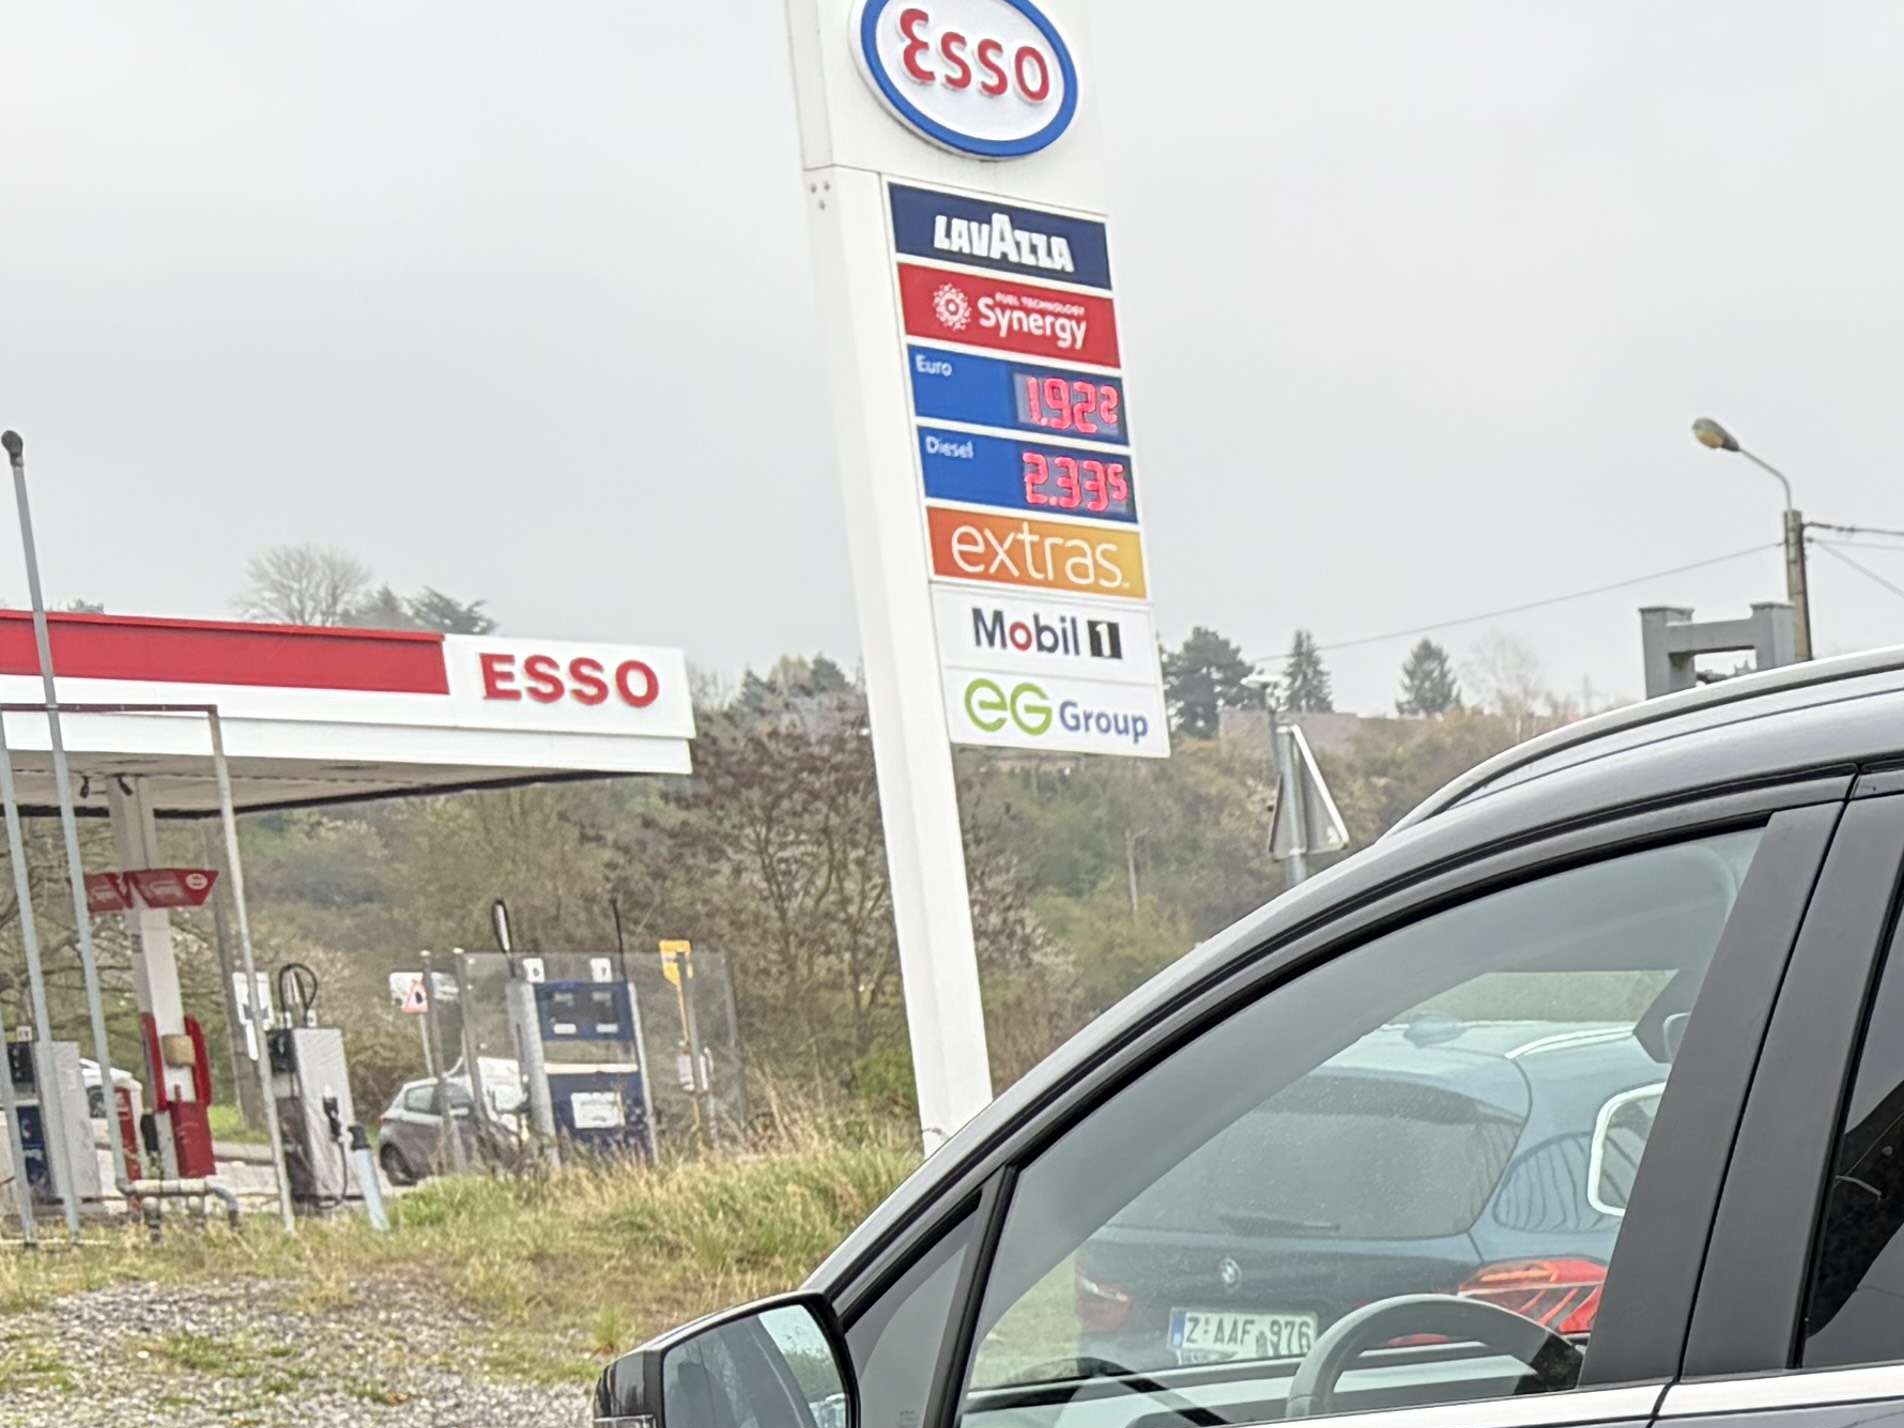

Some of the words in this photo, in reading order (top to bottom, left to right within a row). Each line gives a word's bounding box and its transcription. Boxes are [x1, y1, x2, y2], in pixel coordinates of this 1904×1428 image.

[933, 213, 1075, 272] LAVAZZA
[977, 297, 1087, 350] Synergy
[915, 355, 953, 377] Euro
[925, 436, 974, 459] Diesel
[951, 521, 1123, 588] extras
[971, 607, 1081, 657] Mobil
[479, 652, 661, 708] ESSO
[1059, 700, 1149, 744] Group
